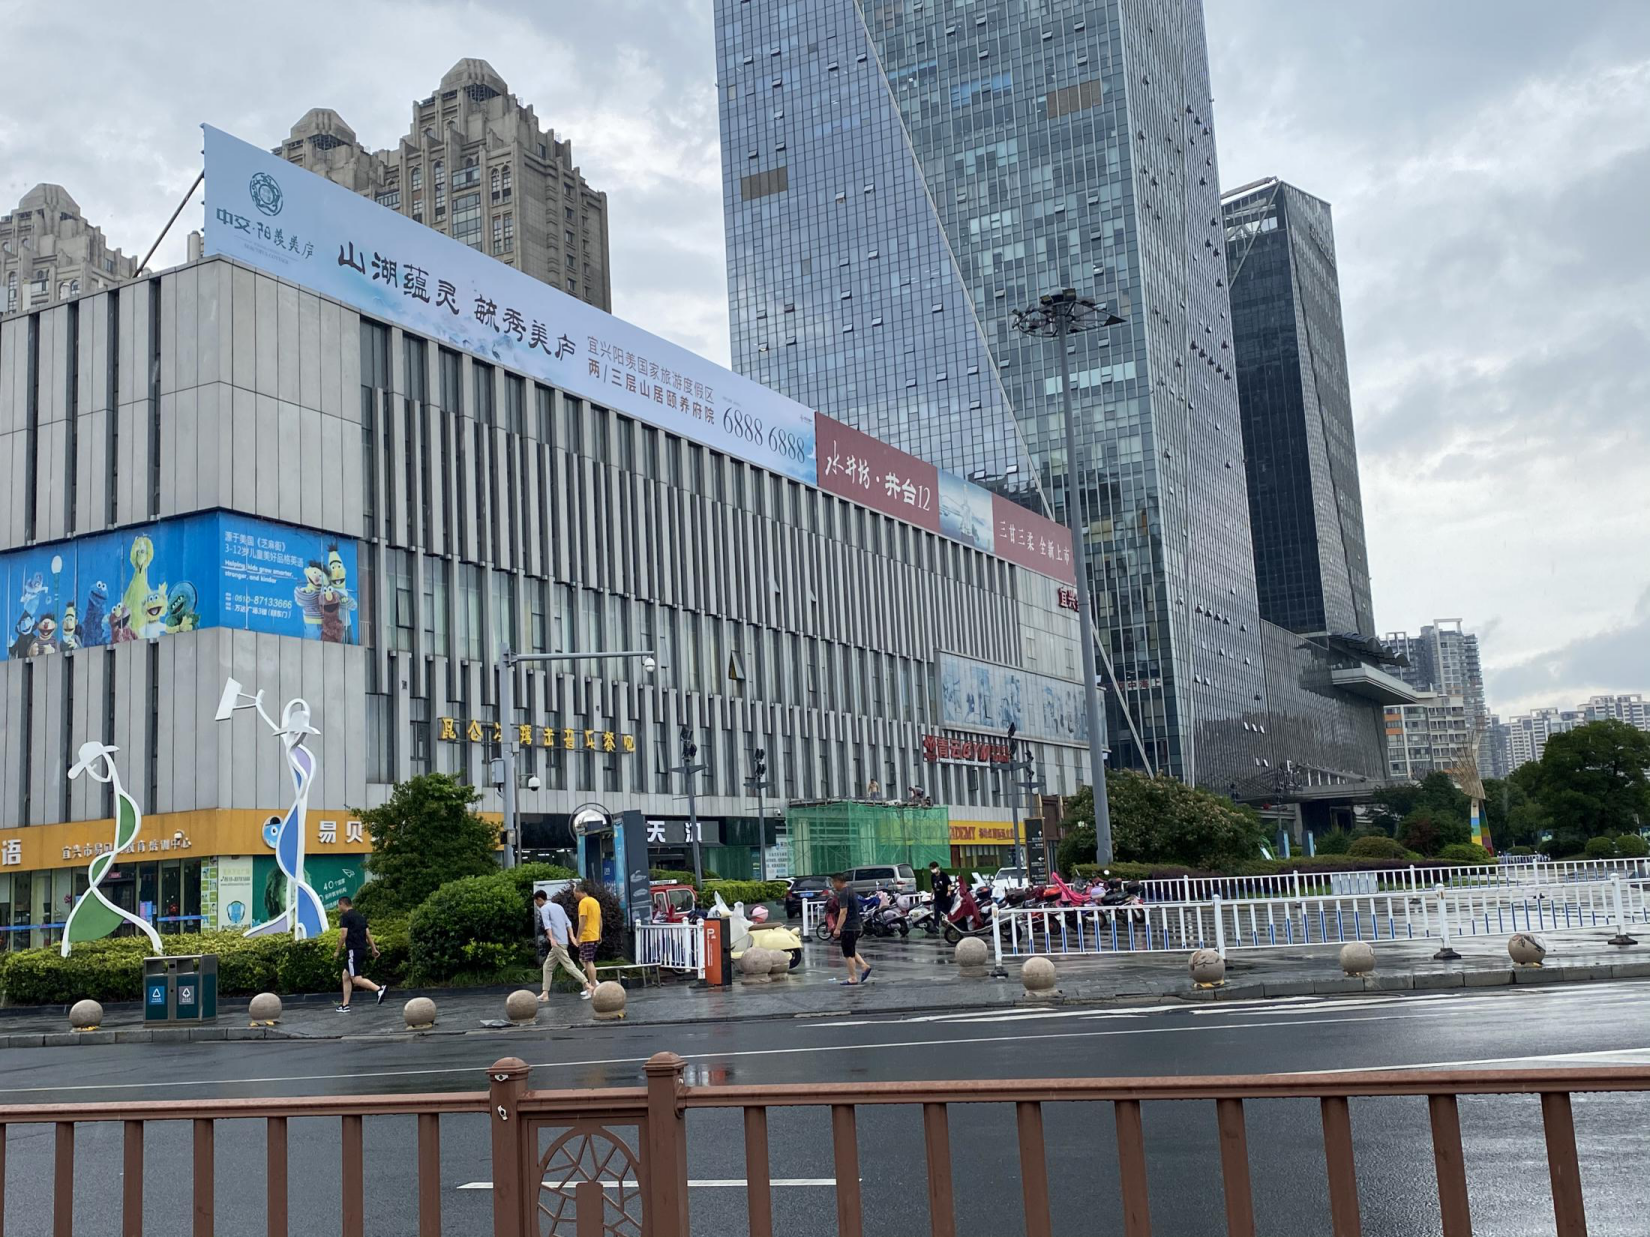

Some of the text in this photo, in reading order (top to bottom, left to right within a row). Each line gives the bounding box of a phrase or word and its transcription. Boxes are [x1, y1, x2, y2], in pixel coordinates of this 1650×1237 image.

[337, 241, 576, 361] 山湖蕴灵 毓秀美庐
[587, 335, 714, 405] 宜兴阳羡国家旅游度假区
[588, 358, 715, 425] 两/三层山居颐养府院
[723, 406, 805, 464] 6888 6888
[1039, 535, 1070, 566] 全新上市
[234, 594, 293, 609] 0510-87133666
[1058, 587, 1079, 612] 宜兴
[318, 820, 380, 843] 易贝
[1, 838, 22, 866] 语
[62, 836, 192, 860] 宜兴市易贝教育培训中心
